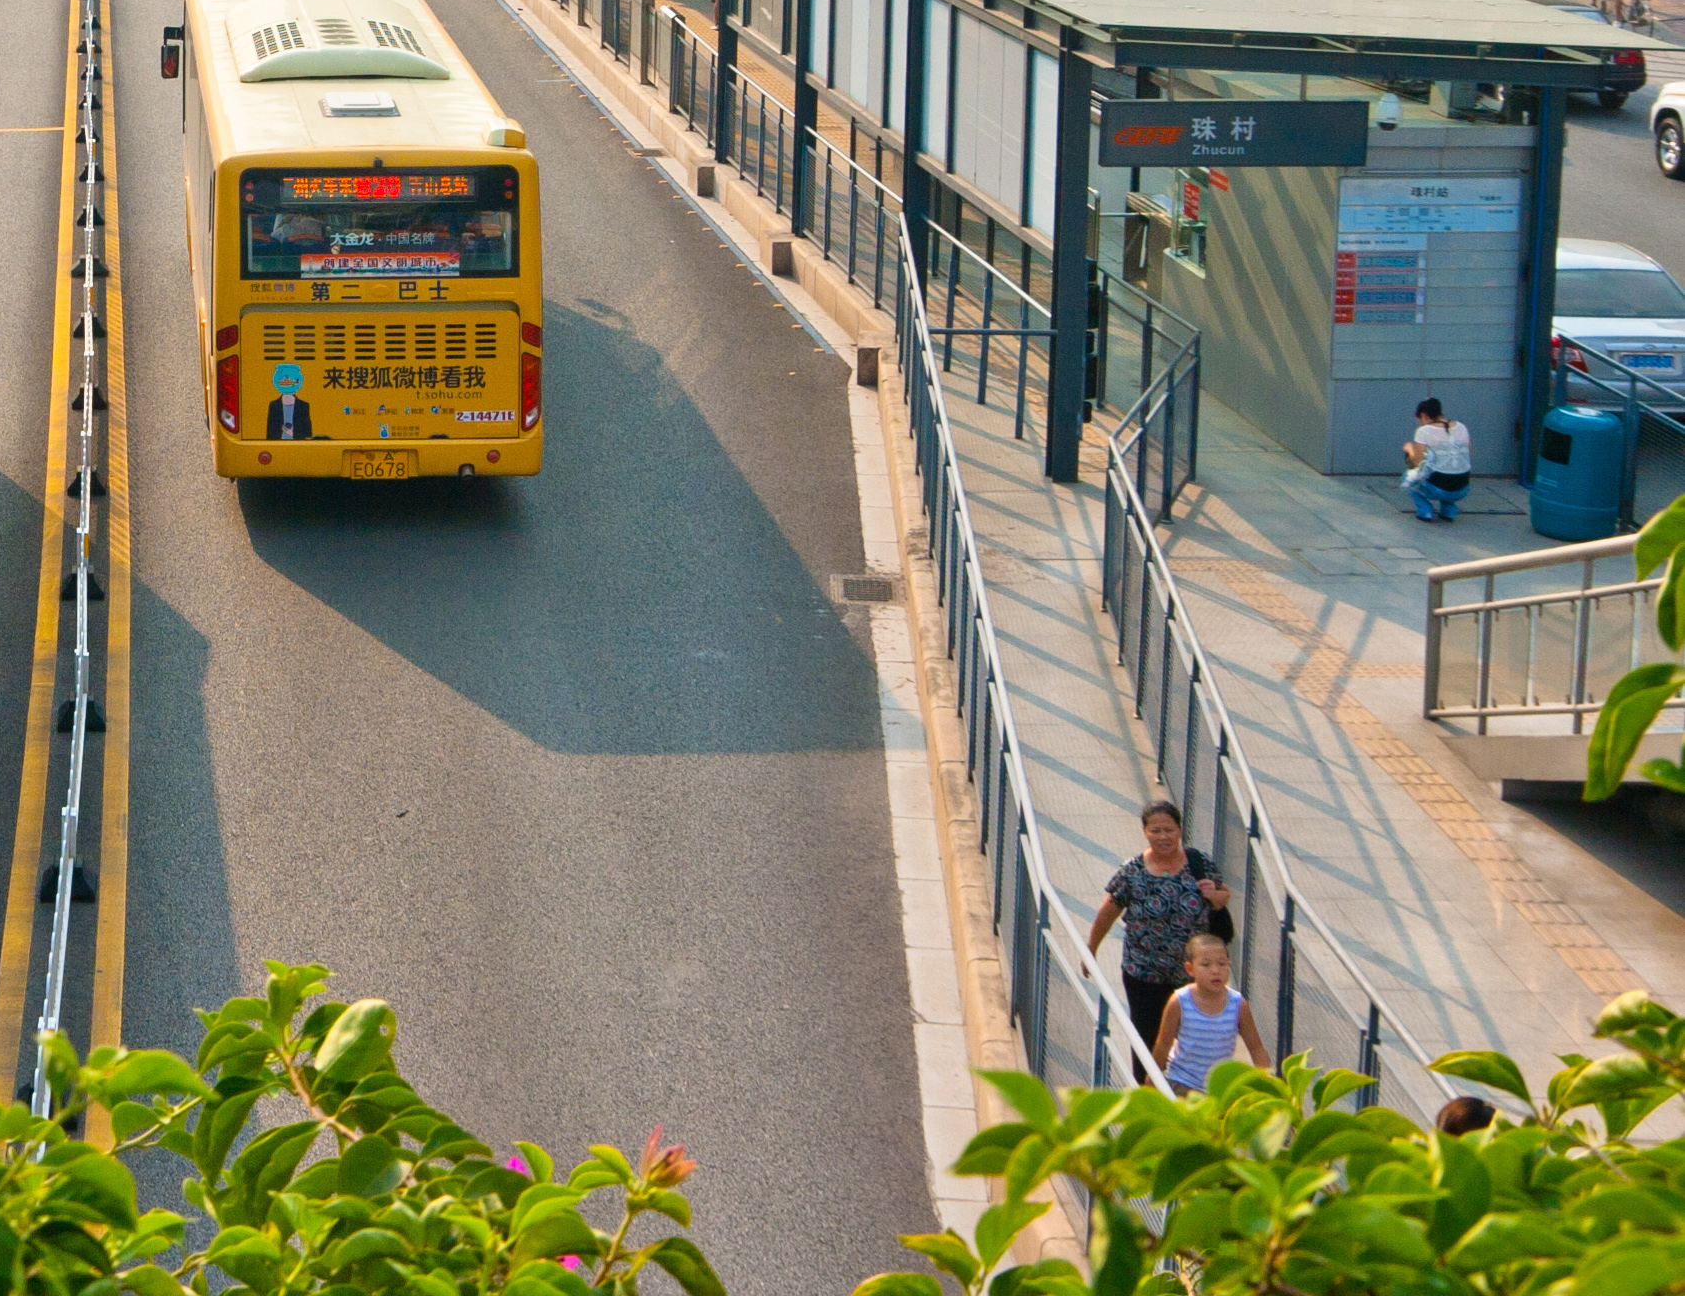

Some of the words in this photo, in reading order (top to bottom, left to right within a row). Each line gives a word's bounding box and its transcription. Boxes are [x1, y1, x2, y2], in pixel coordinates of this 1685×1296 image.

[1191, 116, 1256, 141] 珠村
[1192, 144, 1245, 155] Zhucun
[1411, 186, 1449, 198] 珠村站
[323, 256, 437, 269] 创建全国文明城市
[250, 282, 295, 292] 搜狐微博
[311, 280, 450, 302] 第二巴士
[323, 365, 486, 390] 来搜狐微博看我
[416, 390, 482, 399] t.sohu.com
[354, 462, 405, 477] E0678
